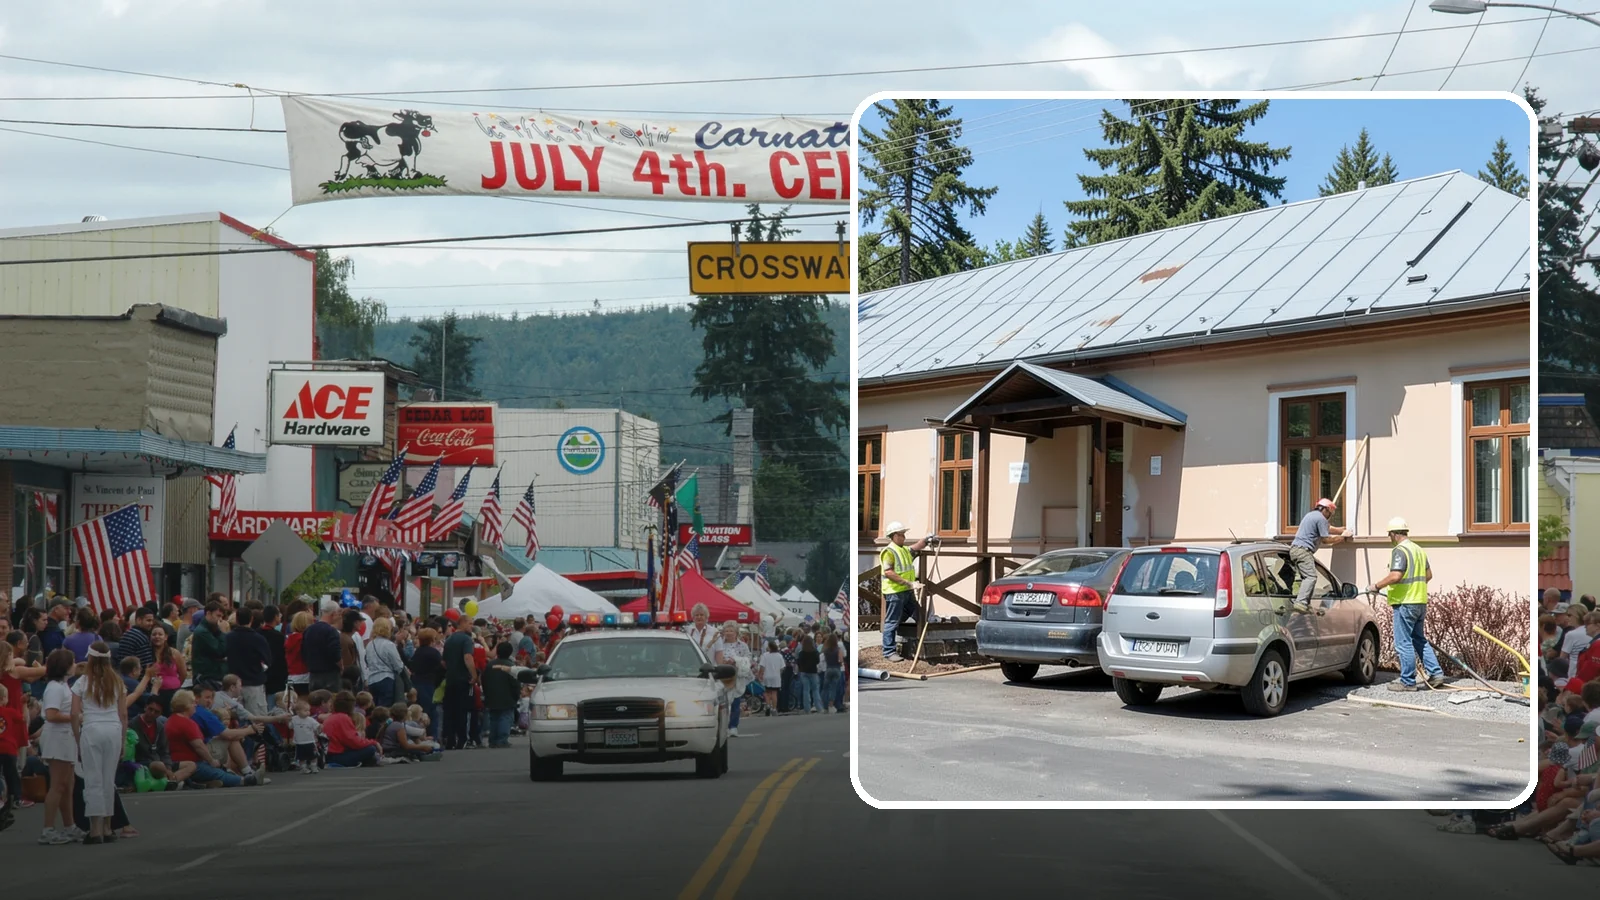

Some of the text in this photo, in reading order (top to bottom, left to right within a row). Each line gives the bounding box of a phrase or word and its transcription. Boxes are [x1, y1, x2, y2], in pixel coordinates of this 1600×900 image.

[695, 121, 850, 150] Carnat
[481, 141, 605, 192] JULY
[632, 150, 746, 198] 4th.
[697, 254, 850, 280] CROSSWA
[283, 380, 373, 420] ACE
[405, 409, 485, 422] CEDAR LOG
[283, 421, 371, 437] Hardware
[95, 485, 124, 495] Vincent
[126, 486, 136, 495] de
[137, 486, 155, 495] Paul
[688, 527, 741, 535] CRNATION
[699, 535, 730, 543] GLASS
